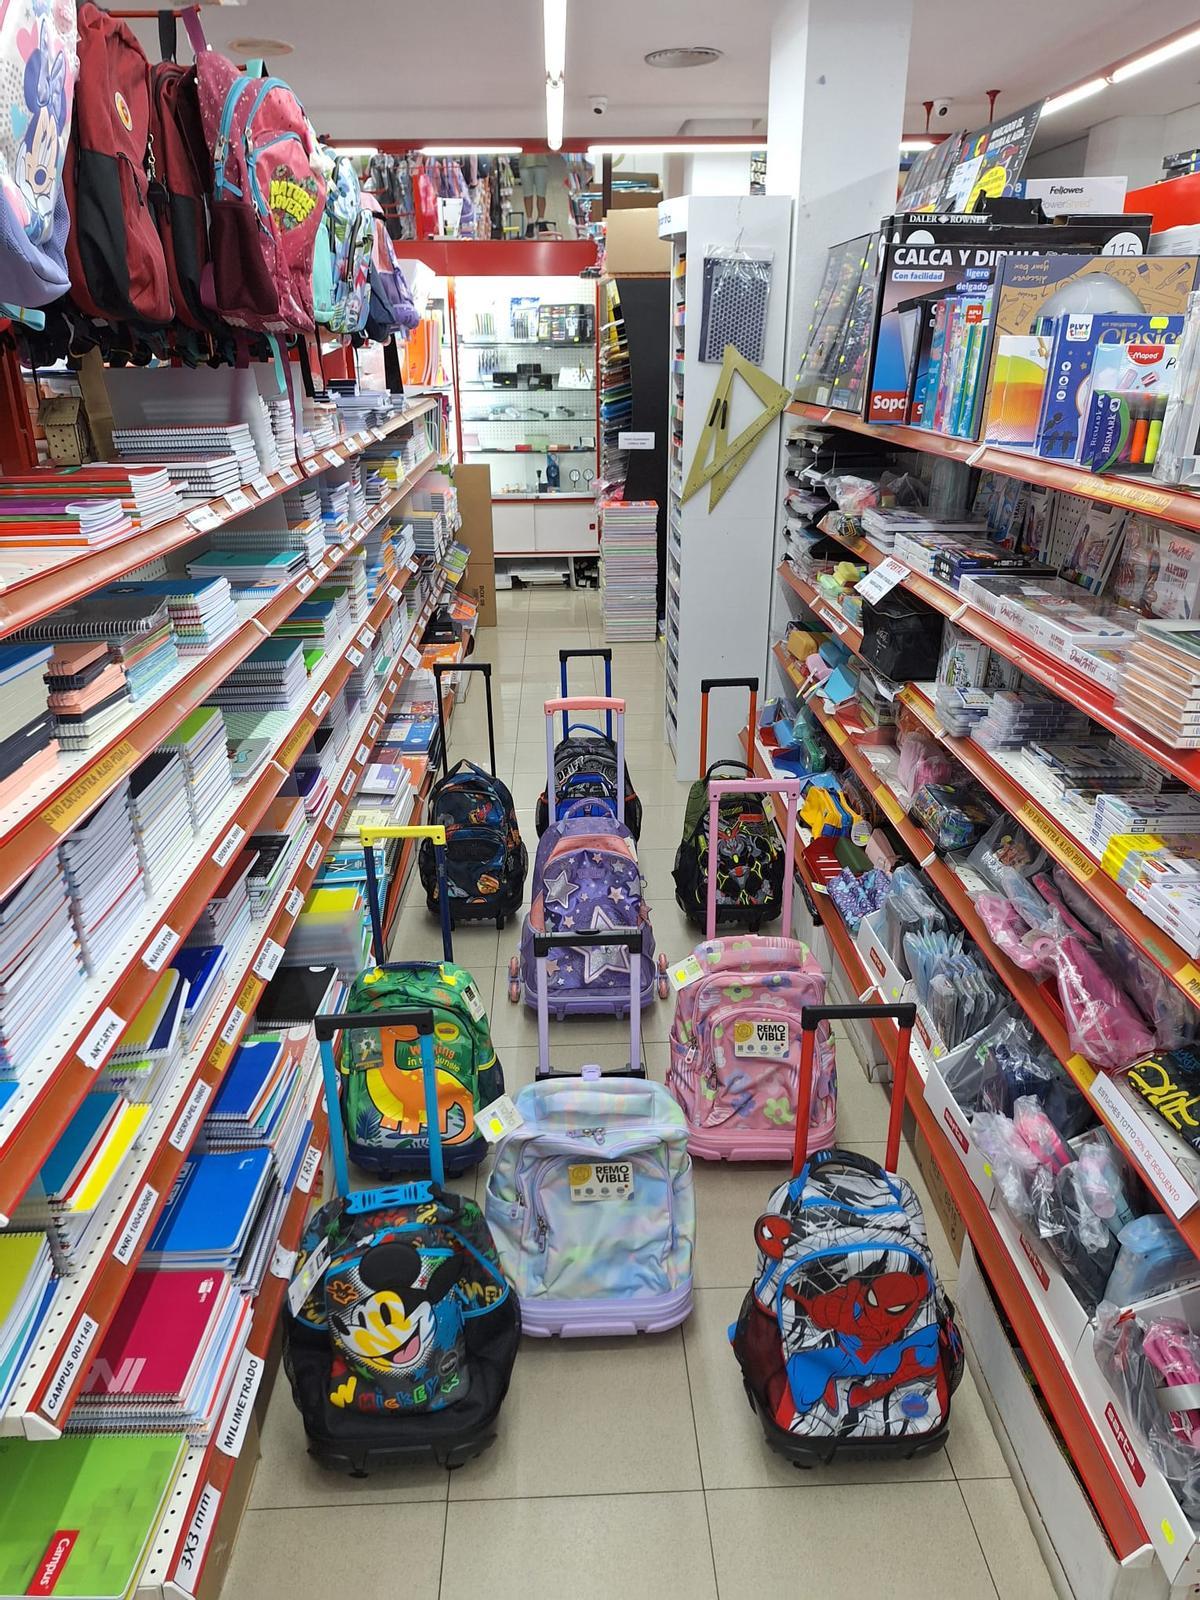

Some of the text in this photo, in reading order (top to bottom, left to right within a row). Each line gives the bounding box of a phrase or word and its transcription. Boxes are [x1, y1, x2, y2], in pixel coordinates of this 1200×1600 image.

[1050, 185, 1084, 195] Fellowes
[910, 215, 937, 223] DALER
[894, 248, 972, 266] CALCA Y
[894, 271, 943, 280] Con facilidad
[966, 269, 990, 279] ligero
[956, 283, 988, 293] delgado
[1132, 352, 1159, 360] Maped
[1102, 413, 1117, 453] BISMARK
[1059, 840, 1074, 858] ALGO
[1071, 853, 1094, 876] PIDALO
[150, 931, 173, 964] NAVIGATOR
[90, 1020, 118, 1060] ANTARTIK
[757, 1024, 785, 1033] REMO
[757, 1032, 786, 1041] VIBLE
[172, 1103, 198, 1144] LIDERPAPEL
[1098, 1087, 1121, 1118] ESTUCHES
[1119, 1116, 1137, 1139] TOTTO
[1144, 1151, 1153, 1163] DE
[1151, 1160, 1180, 1202] DESCUENTO
[305, 1150, 319, 1174] RAYA
[595, 1165, 629, 1174] REMO
[596, 1173, 630, 1183] VIBLE
[118, 1234, 132, 1258] ENRI
[48, 1321, 93, 1410] CAMPUS 001149
[223, 1359, 258, 1449] MILIMETRADO
[180, 1492, 211, 1571] 3X3 mm
[40, 1537, 70, 1587] Campus
